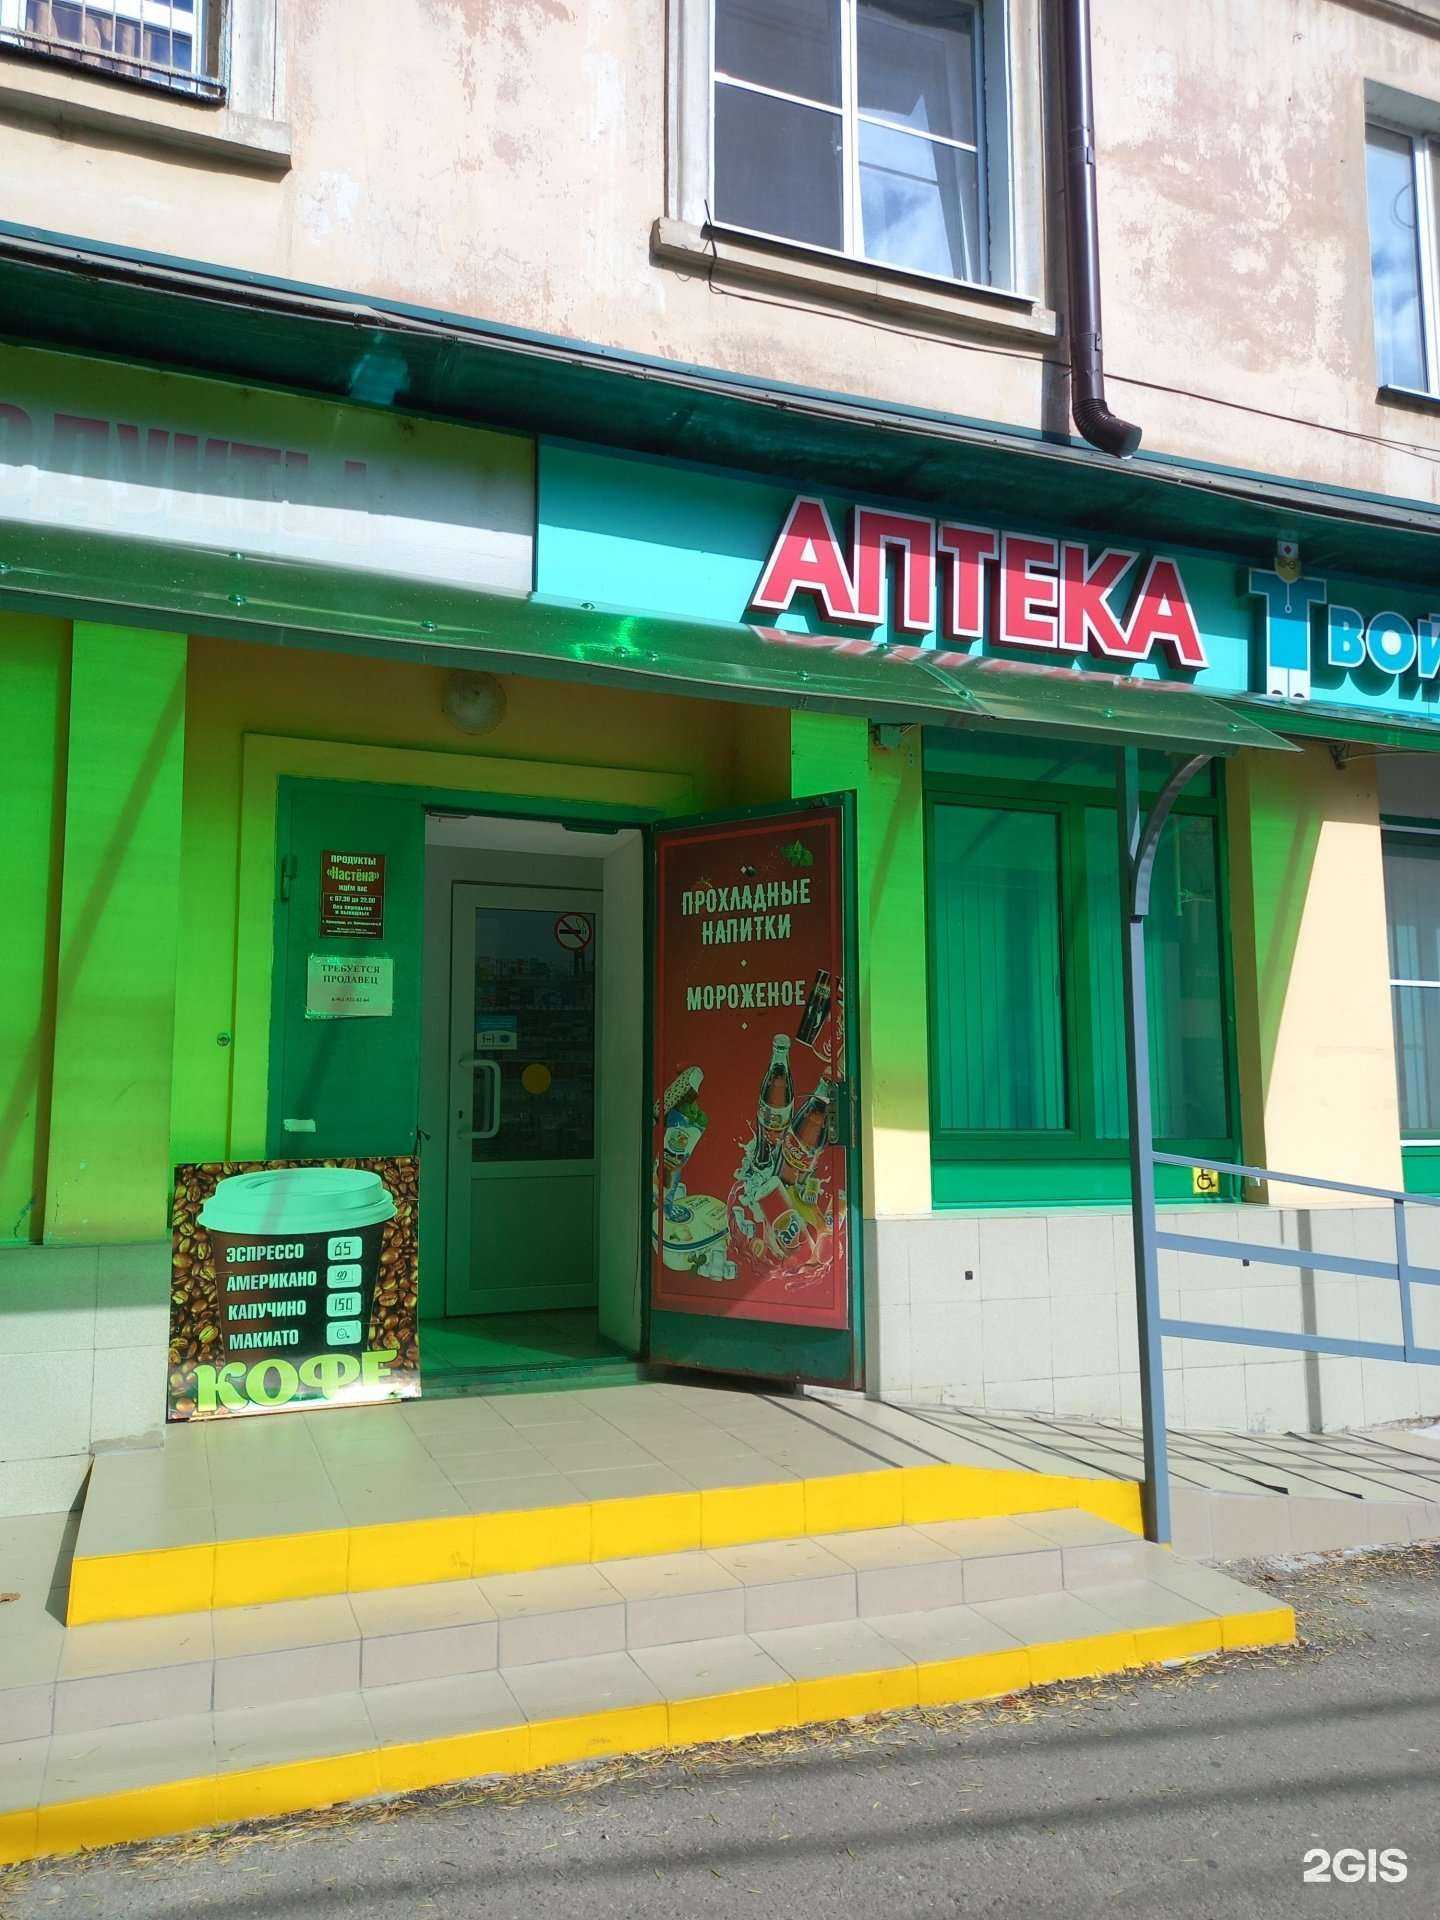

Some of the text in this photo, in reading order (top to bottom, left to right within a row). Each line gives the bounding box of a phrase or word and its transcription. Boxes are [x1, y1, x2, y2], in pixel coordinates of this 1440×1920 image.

[750, 494, 1209, 670] АПТЕКА
[330, 854, 377, 866] ПРОДУКТЫ
[681, 877, 812, 917] ПРОХЛАДНЫЕ
[701, 913, 792, 946] НАПИТКИ
[321, 964, 380, 974] ТРЕБУЕТСЯ
[323, 975, 378, 985] ПРОДАВЕЦ
[686, 979, 807, 1012] МОРОЖЕНОЕ
[225, 1243, 305, 1263] ЭСПРЕССО
[334, 1241, 352, 1257] 65
[226, 1270, 318, 1292] АМЕРИКАНО
[228, 1300, 307, 1321] КАПУЧИНО
[334, 1297, 353, 1311] 150
[228, 1328, 300, 1351] МАКИАТО
[193, 1348, 399, 1413] КОФЕ
